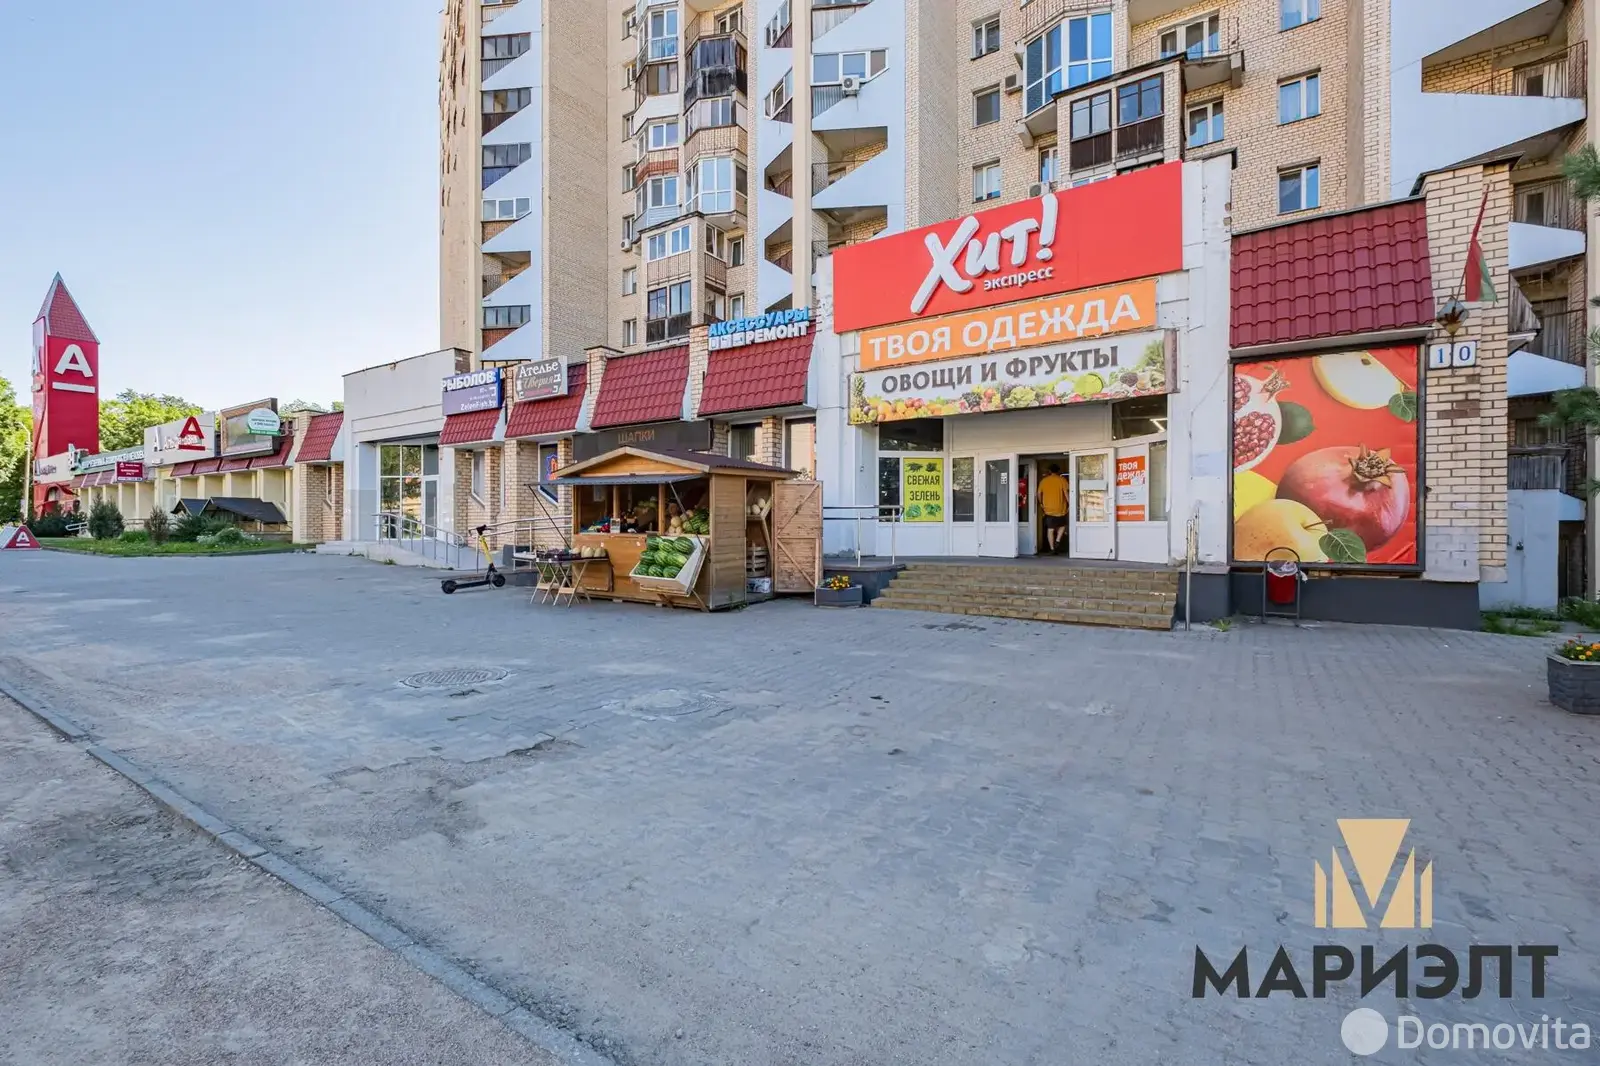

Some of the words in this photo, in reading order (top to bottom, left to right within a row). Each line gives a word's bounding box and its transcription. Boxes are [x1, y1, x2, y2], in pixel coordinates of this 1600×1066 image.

[910, 193, 1058, 314] Хит!
[984, 266, 1054, 290] экспресс
[709, 306, 809, 336] АКСЕССУАРЫ
[868, 326, 951, 362] ТВОЯ
[962, 294, 1140, 351] ОДЕЖДА
[745, 321, 809, 345] РЕМОНТ
[1438, 345, 1471, 363] 10
[519, 361, 559, 378] Ателье
[881, 364, 972, 394] ОВОЩИ
[981, 361, 997, 381] И
[1005, 346, 1118, 379] ФРУКТЫ
[440, 371, 496, 391] РЫБОЛОВ
[618, 429, 655, 444] ШАПКИ
[907, 475, 940, 485] СВЕЖАЯ
[909, 490, 941, 501] ЗЕЛЕНЬ
